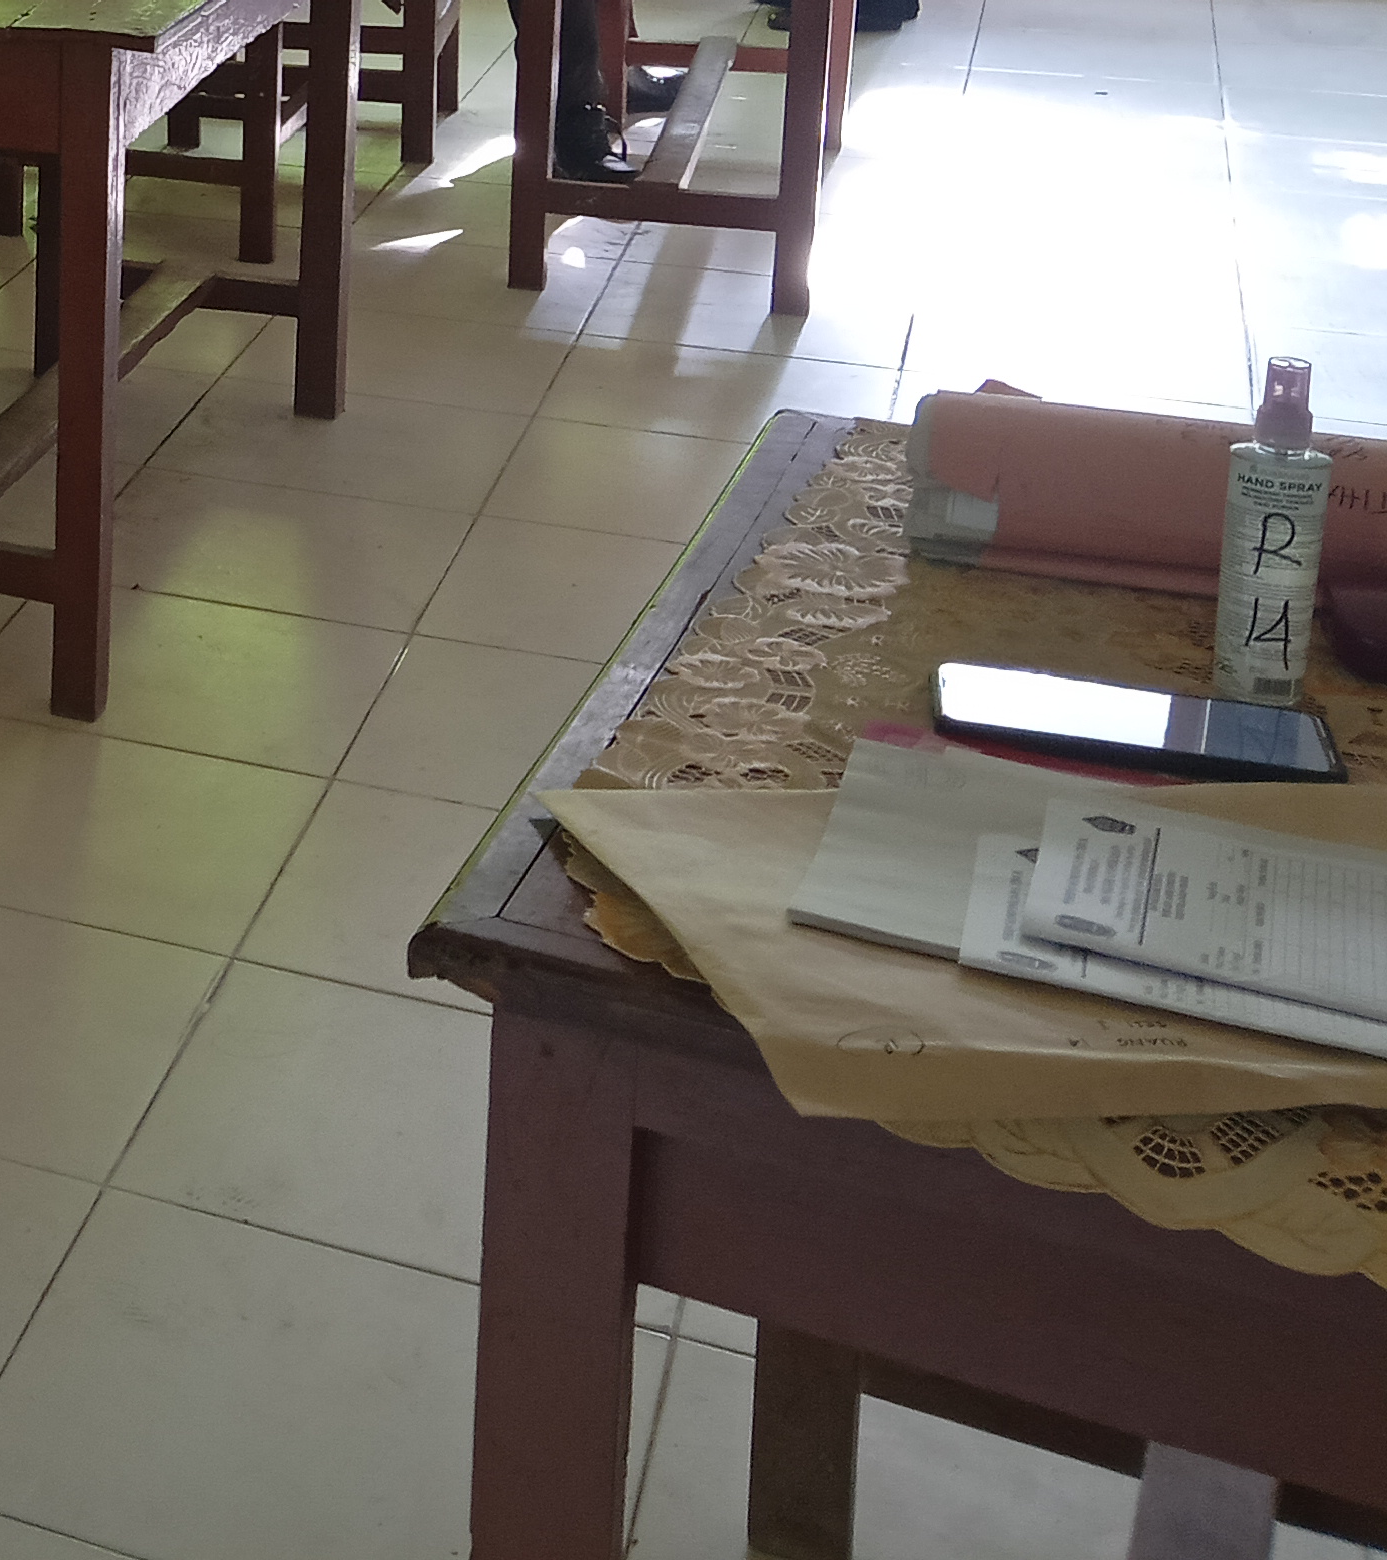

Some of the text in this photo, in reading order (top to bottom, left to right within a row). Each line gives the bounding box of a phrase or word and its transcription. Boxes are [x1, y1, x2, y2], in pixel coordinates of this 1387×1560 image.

[1237, 472, 1323, 493] HAND SPRAY
[1252, 512, 1303, 575] R
